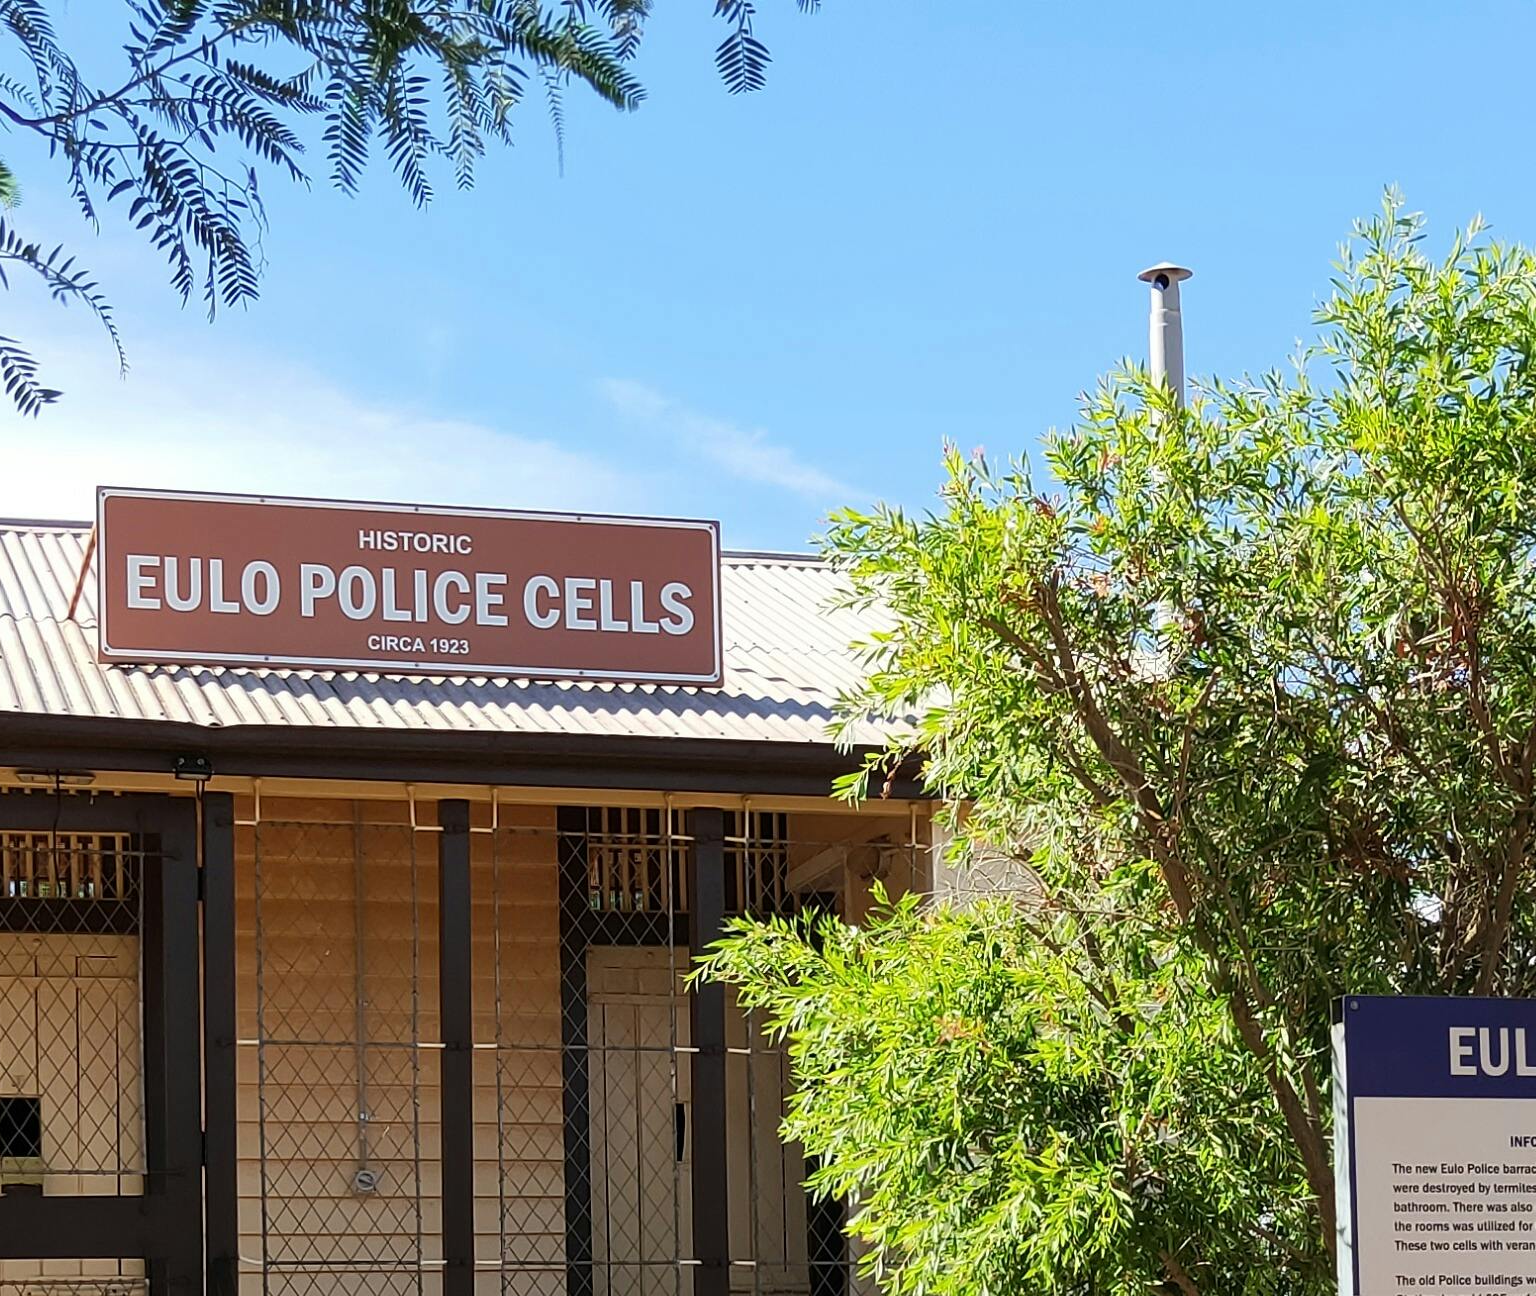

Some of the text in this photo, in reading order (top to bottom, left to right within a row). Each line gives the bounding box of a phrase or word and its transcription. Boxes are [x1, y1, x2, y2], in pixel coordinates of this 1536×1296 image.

[358, 529, 473, 555] HISTORIC
[126, 553, 695, 635] EULO POLICE CELLS
[367, 634, 470, 655] CIRCA 1923
[1391, 1163, 1412, 1174] The
[1414, 1165, 1438, 1173] new
[1440, 1162, 1464, 1174] Eulo
[1466, 1163, 1500, 1174] Police
[1392, 1184, 1419, 1193] were
[1421, 1182, 1475, 1195] destroyed
[1478, 1182, 1491, 1195] by
[1394, 1239, 1427, 1251] These
[1429, 1240, 1450, 1250] two
[1452, 1239, 1477, 1250] cells
[1479, 1239, 1503, 1250] with
